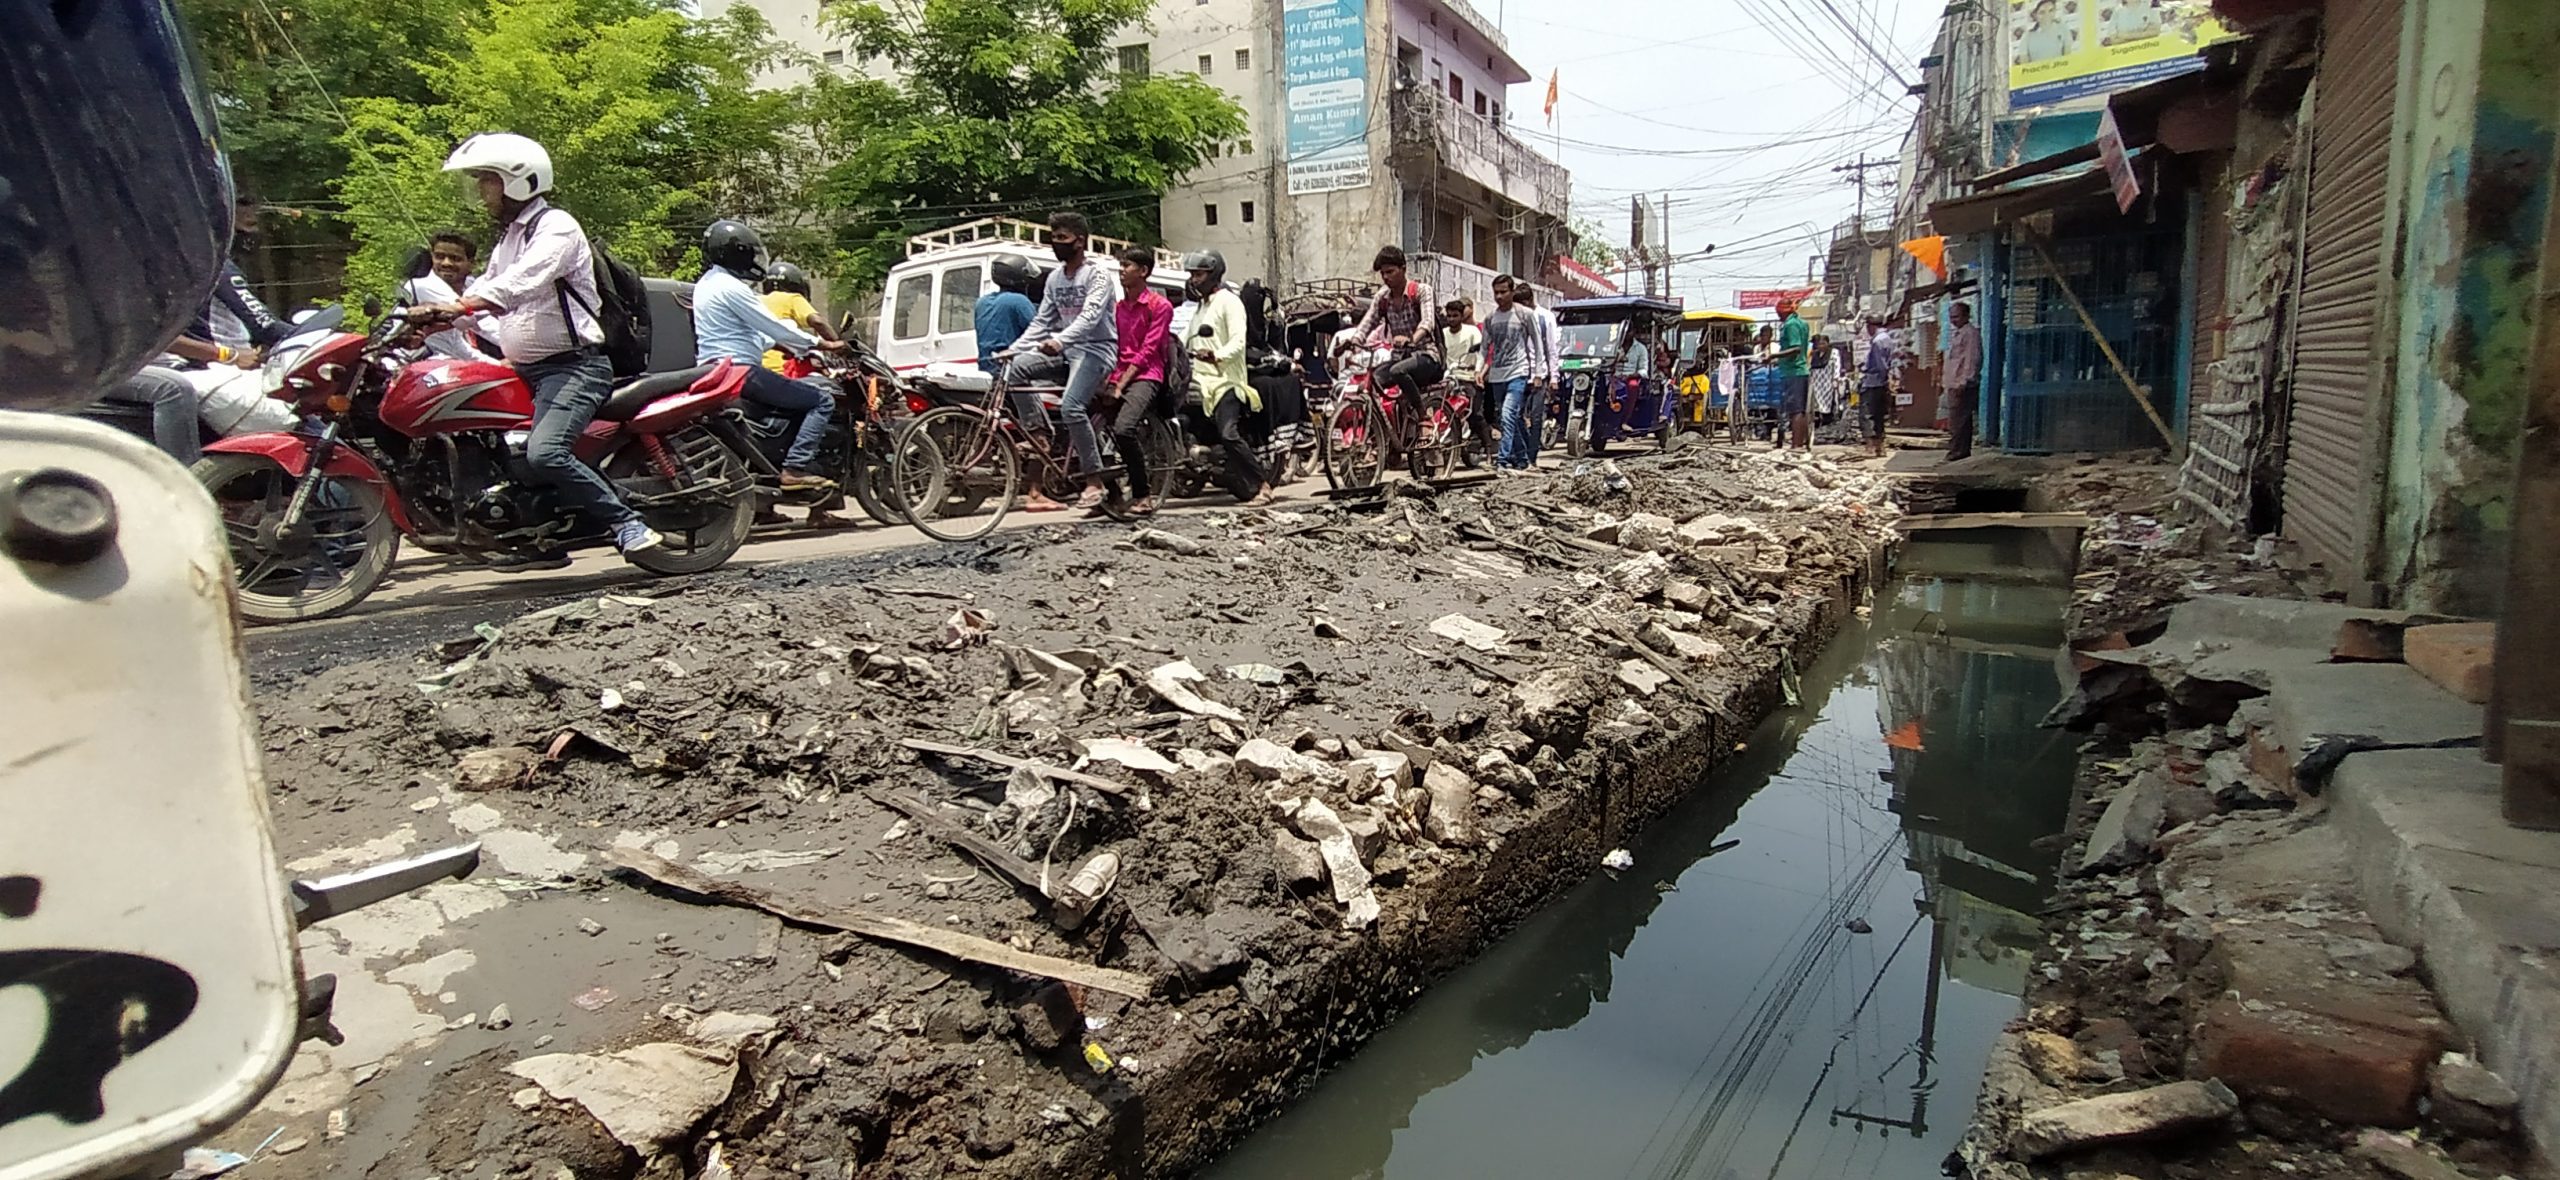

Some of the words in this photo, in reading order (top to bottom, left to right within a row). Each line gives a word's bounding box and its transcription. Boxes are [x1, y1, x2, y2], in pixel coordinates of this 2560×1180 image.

[2110, 40, 2161, 56] Sugandha
[2021, 63, 2050, 75] Prachi
[2052, 61, 2069, 70] Jha
[1293, 112, 1323, 124] Aman
[1326, 107, 1361, 120] Kumar
[230, 275, 275, 328] URB
